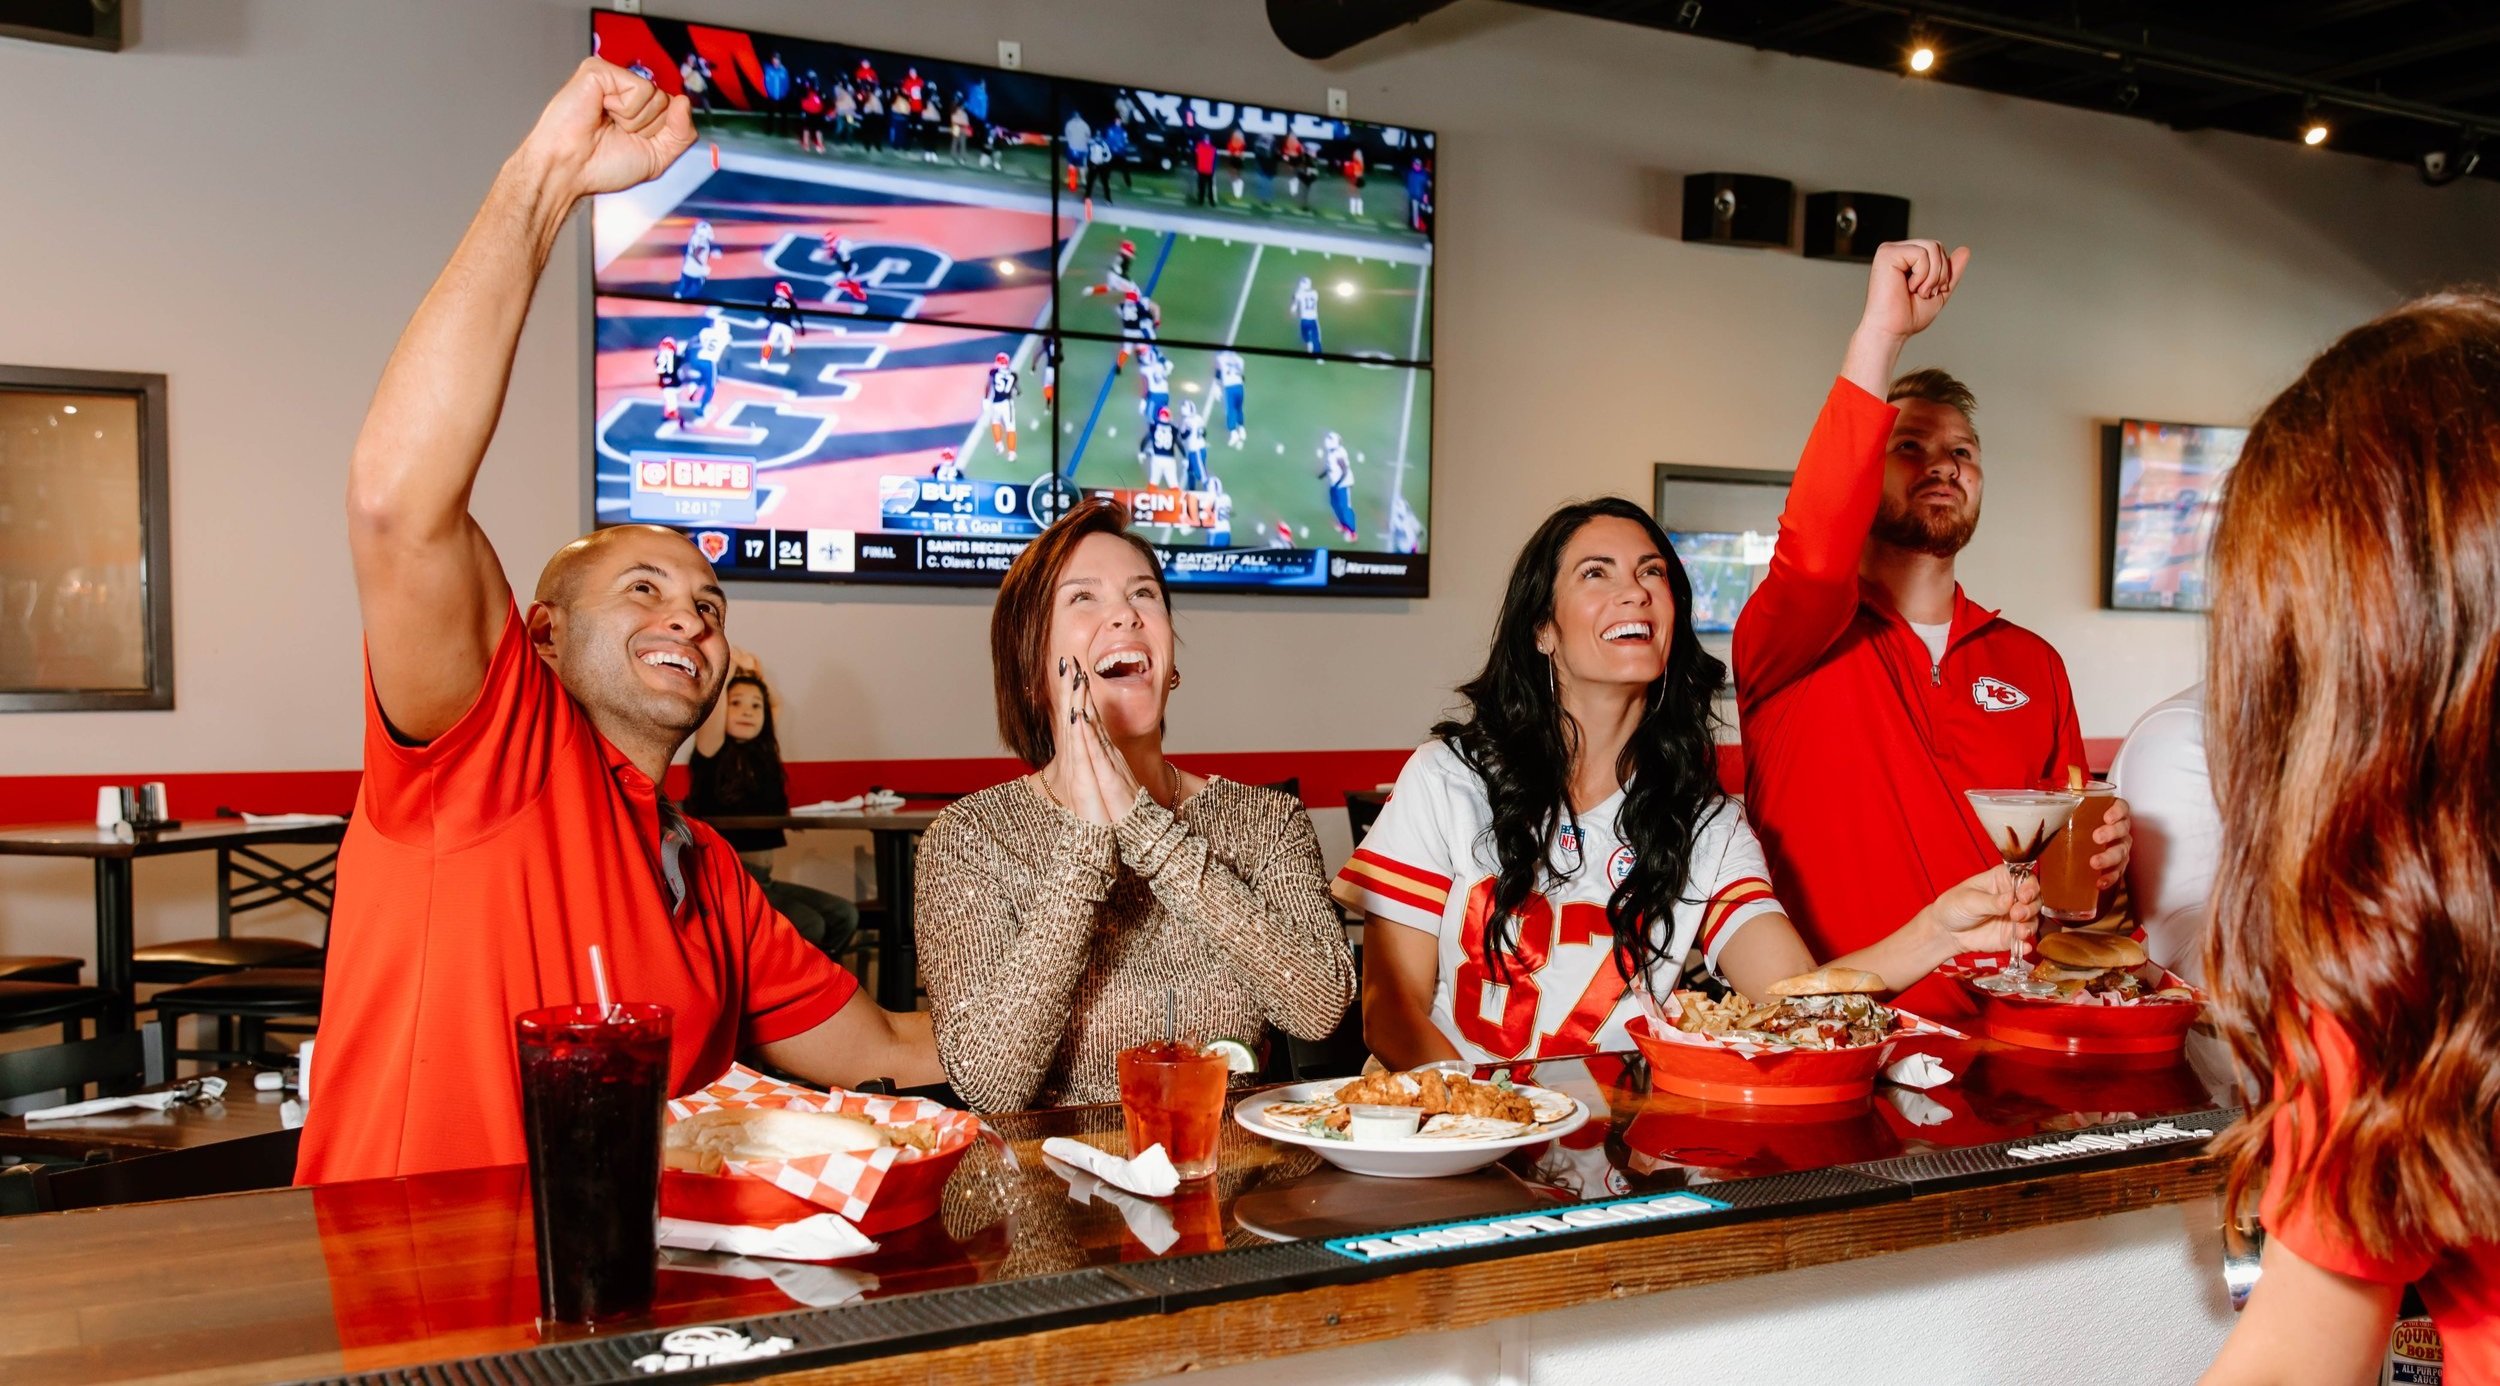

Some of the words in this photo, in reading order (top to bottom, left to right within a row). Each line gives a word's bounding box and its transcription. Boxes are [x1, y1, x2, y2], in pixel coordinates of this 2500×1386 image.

[994, 372, 1014, 393] 57
[921, 482, 973, 502] BUF
[994, 485, 1016, 514] 0
[1133, 492, 1174, 512] CIN
[933, 518, 953, 533] 1st
[971, 518, 1003, 534] Goal
[744, 540, 765, 558] 17
[778, 541, 803, 559] 24
[862, 545, 897, 559] FINAL
[926, 539, 970, 554] SAINTS
[1176, 551, 1223, 565] CATCH
[1346, 561, 1408, 576] NETWORK
[1986, 685, 2018, 704] KC
[1453, 873, 1646, 1062] 87
[2395, 1328, 2442, 1350] COUNT
[2402, 1364, 2415, 1374] ALL
[2416, 1366, 2443, 1377] PURPO
[2412, 1374, 2439, 1386] SAUCE
